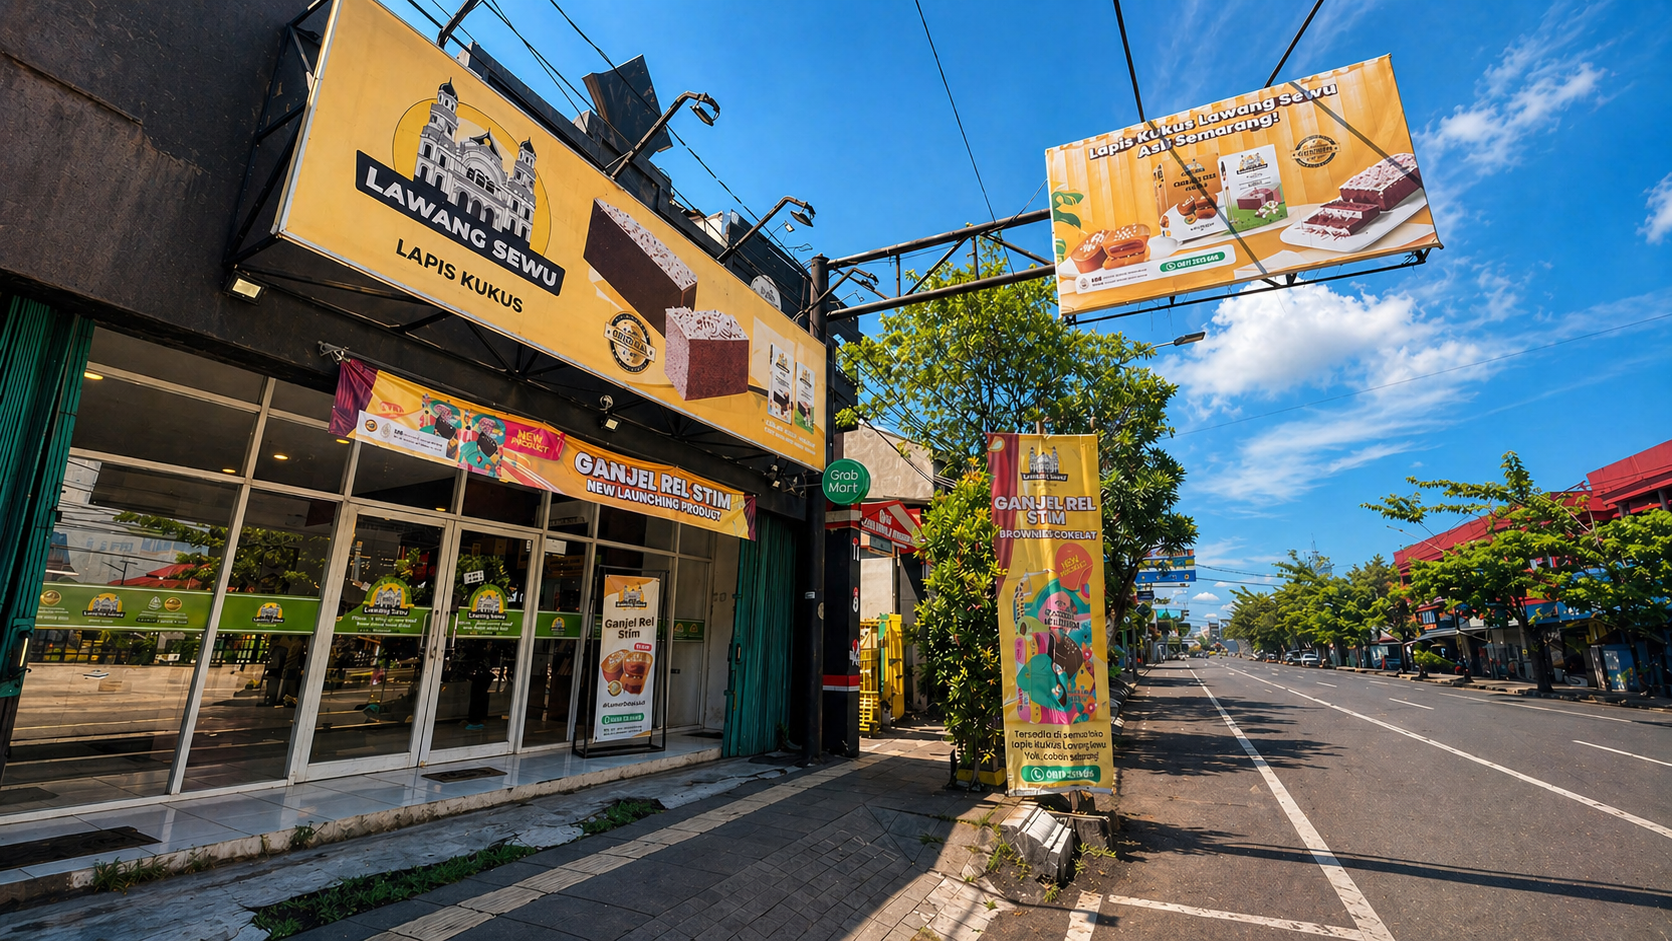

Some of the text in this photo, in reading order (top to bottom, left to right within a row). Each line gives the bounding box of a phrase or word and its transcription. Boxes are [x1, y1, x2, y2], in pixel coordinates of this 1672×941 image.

[1089, 83, 1339, 160] Lapis Kukus Lawang Sewu
[1174, 110, 1280, 147] Semarang!
[365, 166, 558, 288] LAWANG SEWU
[396, 238, 524, 314] LAPIS KUKUS
[517, 429, 544, 444] NEW
[574, 451, 732, 511] GANJEL REL STIM
[828, 469, 859, 494] Grab Mart
[586, 478, 721, 521] NEW LAUNCHING PRODUCT
[994, 495, 1097, 511] GANJEL REL
[1027, 510, 1066, 525] STIM
[1053, 530, 1097, 540] COKELAT
[605, 616, 654, 629] Ganjel Rel
[618, 628, 640, 639] Stim
[1014, 730, 1051, 739] Tersedia
[1053, 730, 1062, 738] di
